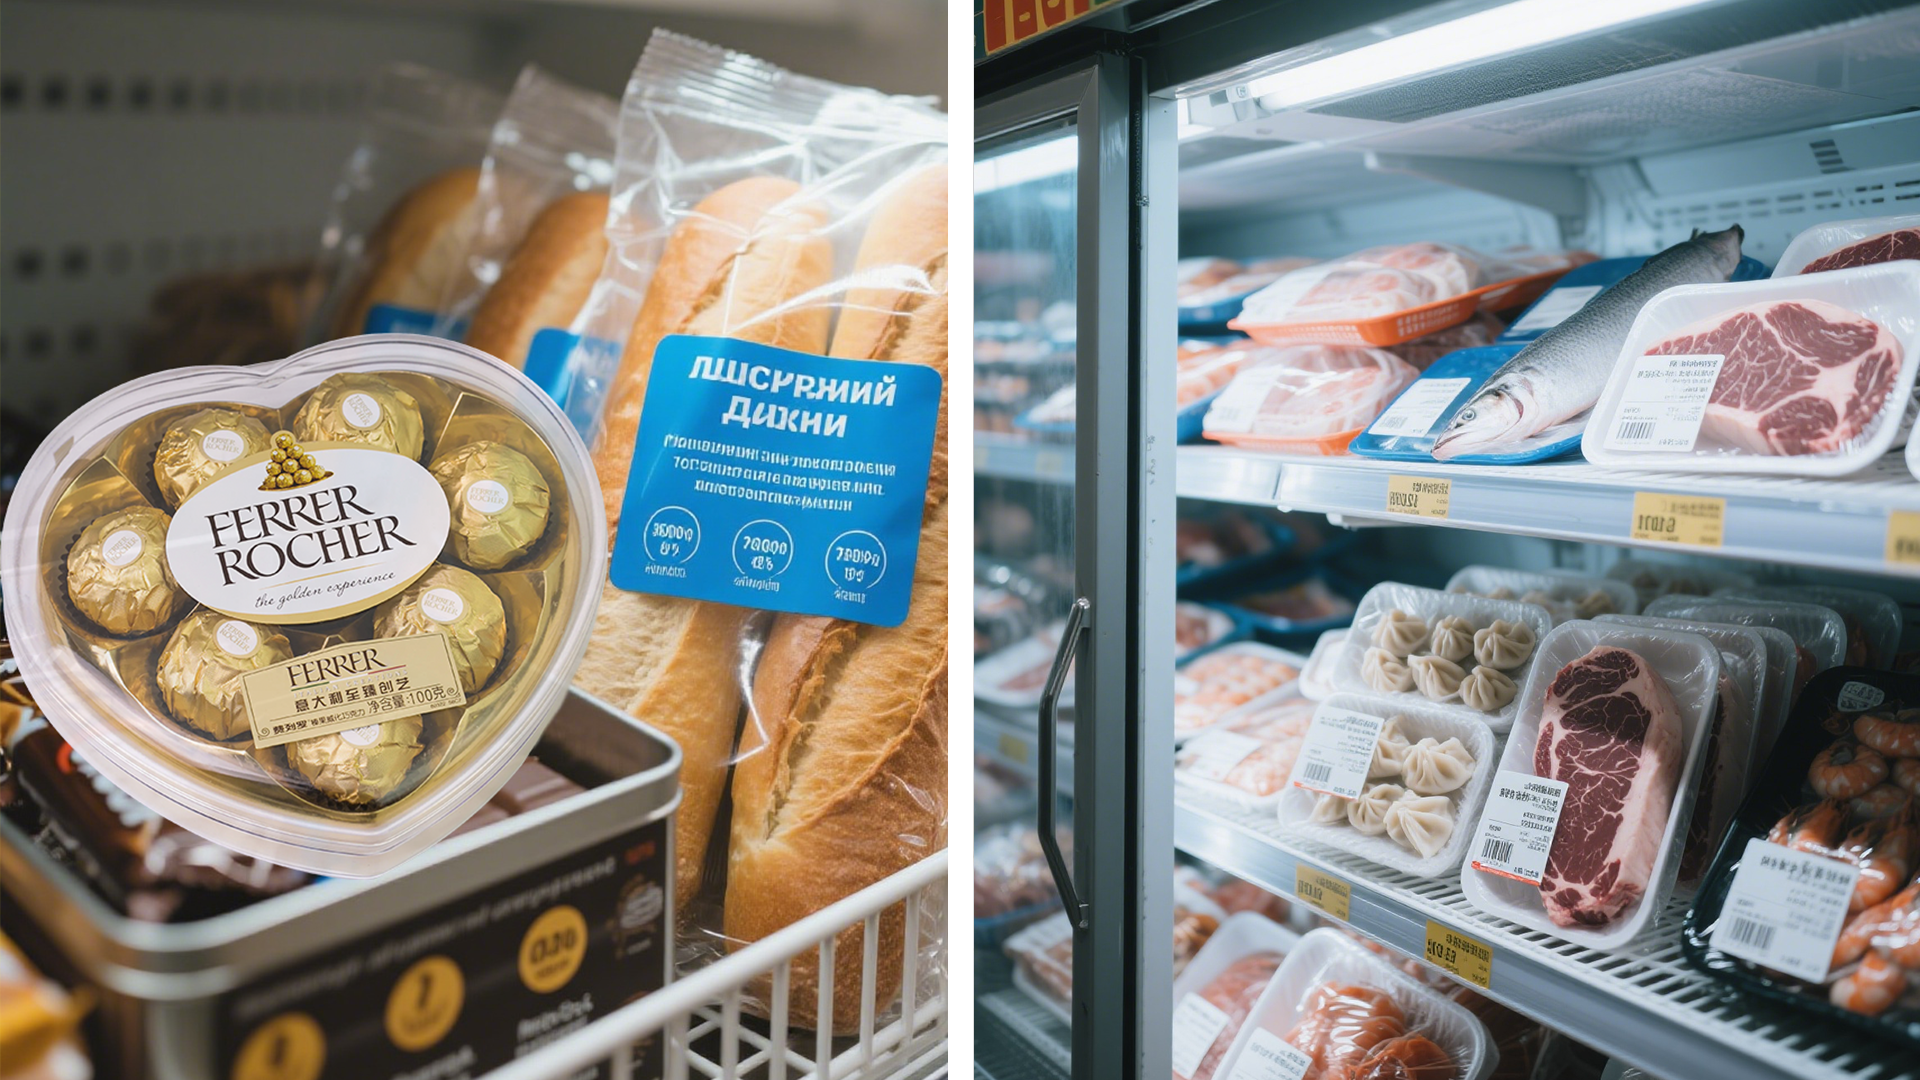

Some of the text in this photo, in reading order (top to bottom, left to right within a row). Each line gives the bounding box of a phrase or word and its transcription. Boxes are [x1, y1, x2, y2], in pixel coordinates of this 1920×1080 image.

[204, 485, 376, 549] FERRER
[215, 515, 418, 587] ROCHER
[255, 570, 396, 610] the golden experience
[286, 648, 388, 688] FERRER
[293, 684, 339, 699] ITALIAN
[294, 677, 411, 713] 意大利至臻创艺
